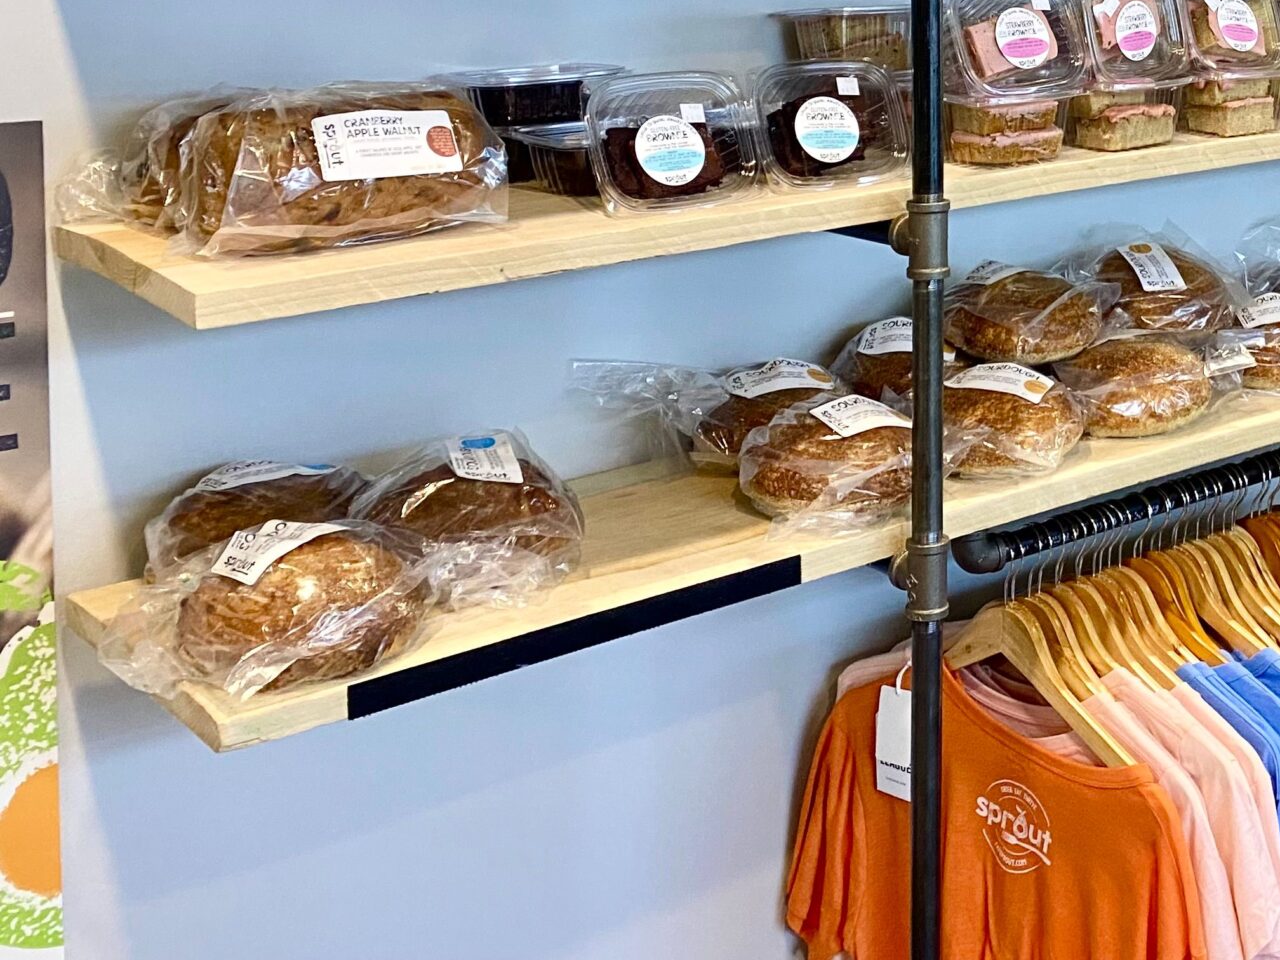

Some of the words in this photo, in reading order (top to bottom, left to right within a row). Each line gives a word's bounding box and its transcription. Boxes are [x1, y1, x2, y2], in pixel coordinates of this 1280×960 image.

[343, 116, 403, 128] CRANBERRY
[347, 128, 380, 139] APPLE
[382, 126, 421, 136] WALNUT
[646, 130, 688, 142] BROWNIE
[975, 795, 1052, 855] sprout
